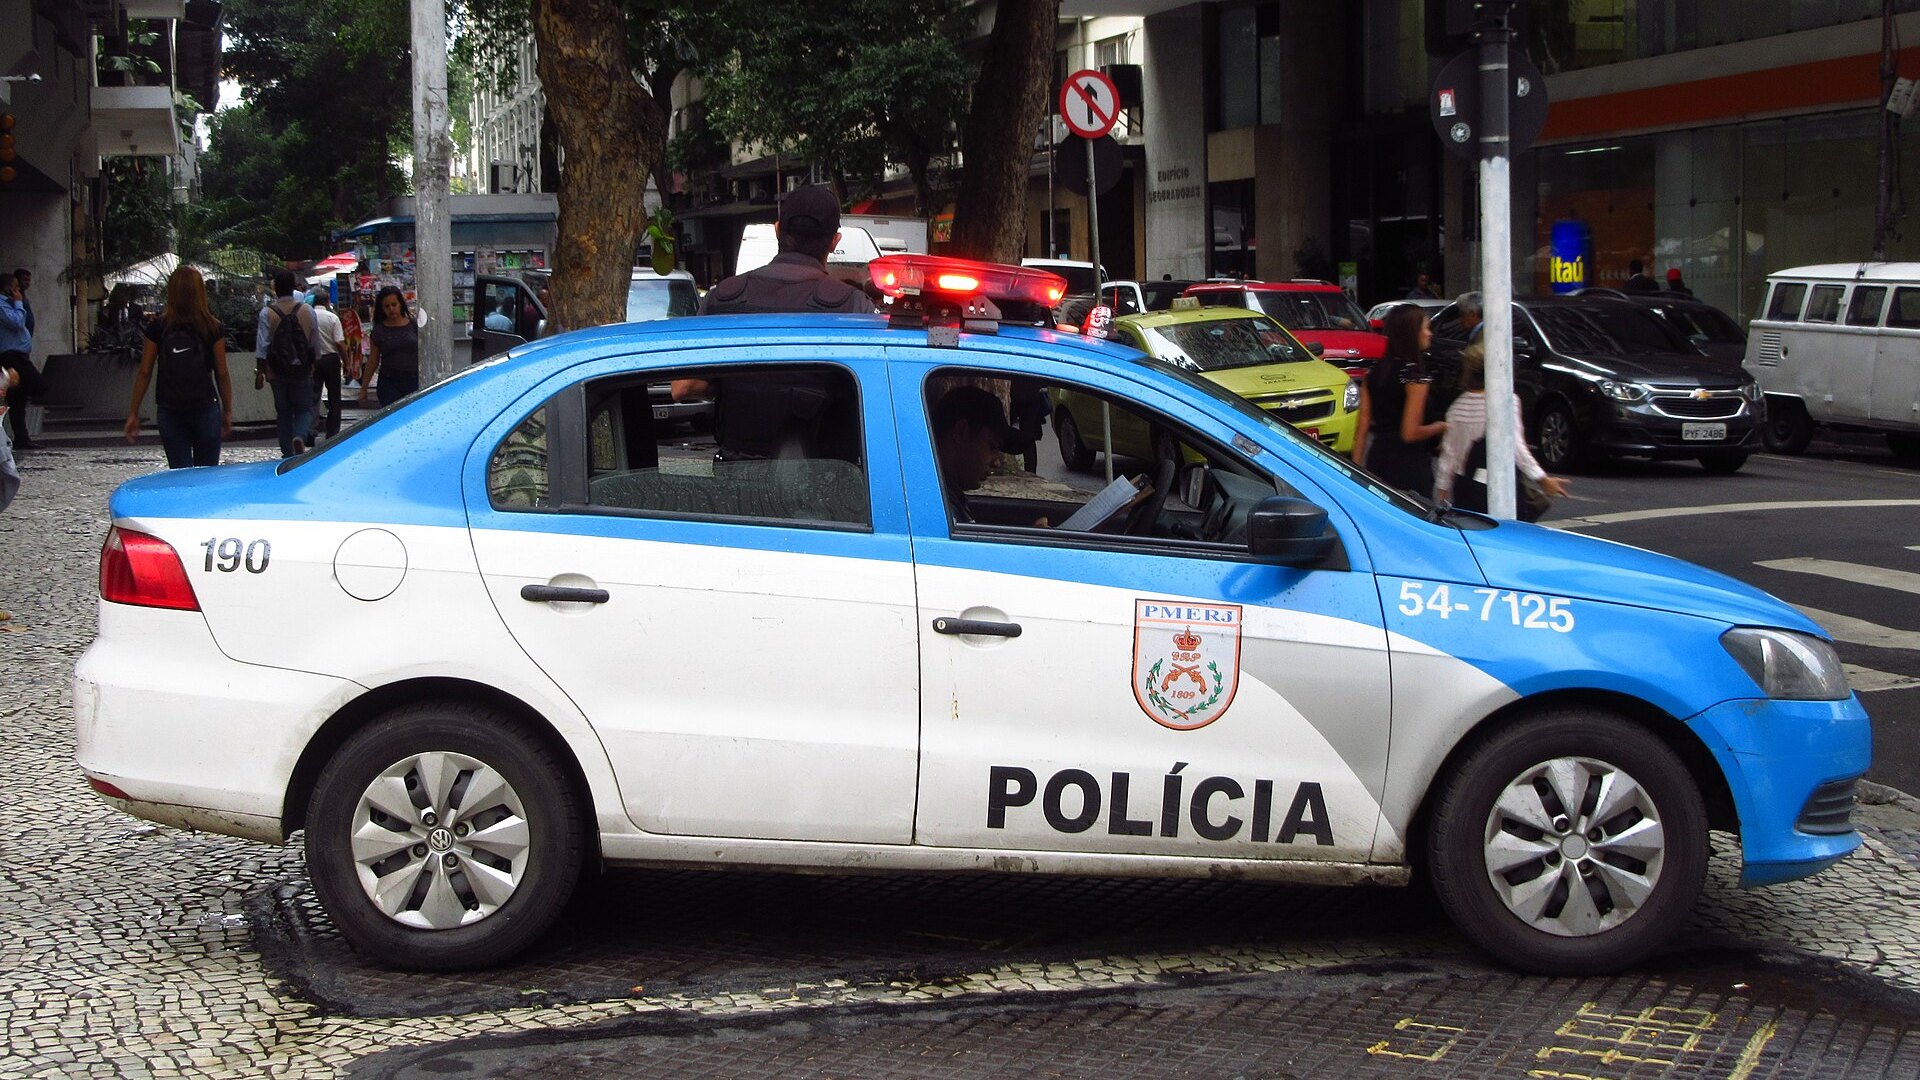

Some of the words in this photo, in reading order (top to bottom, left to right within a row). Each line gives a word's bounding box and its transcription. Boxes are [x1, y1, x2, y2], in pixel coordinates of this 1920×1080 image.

[1550, 256, 1583, 282] Itaú
[200, 537, 271, 574] 190
[1144, 605, 1233, 622] PMERJ
[1399, 581, 1574, 633] 54-7125
[1171, 690, 1195, 699] 1809
[987, 761, 1334, 846] POLÍCIA
